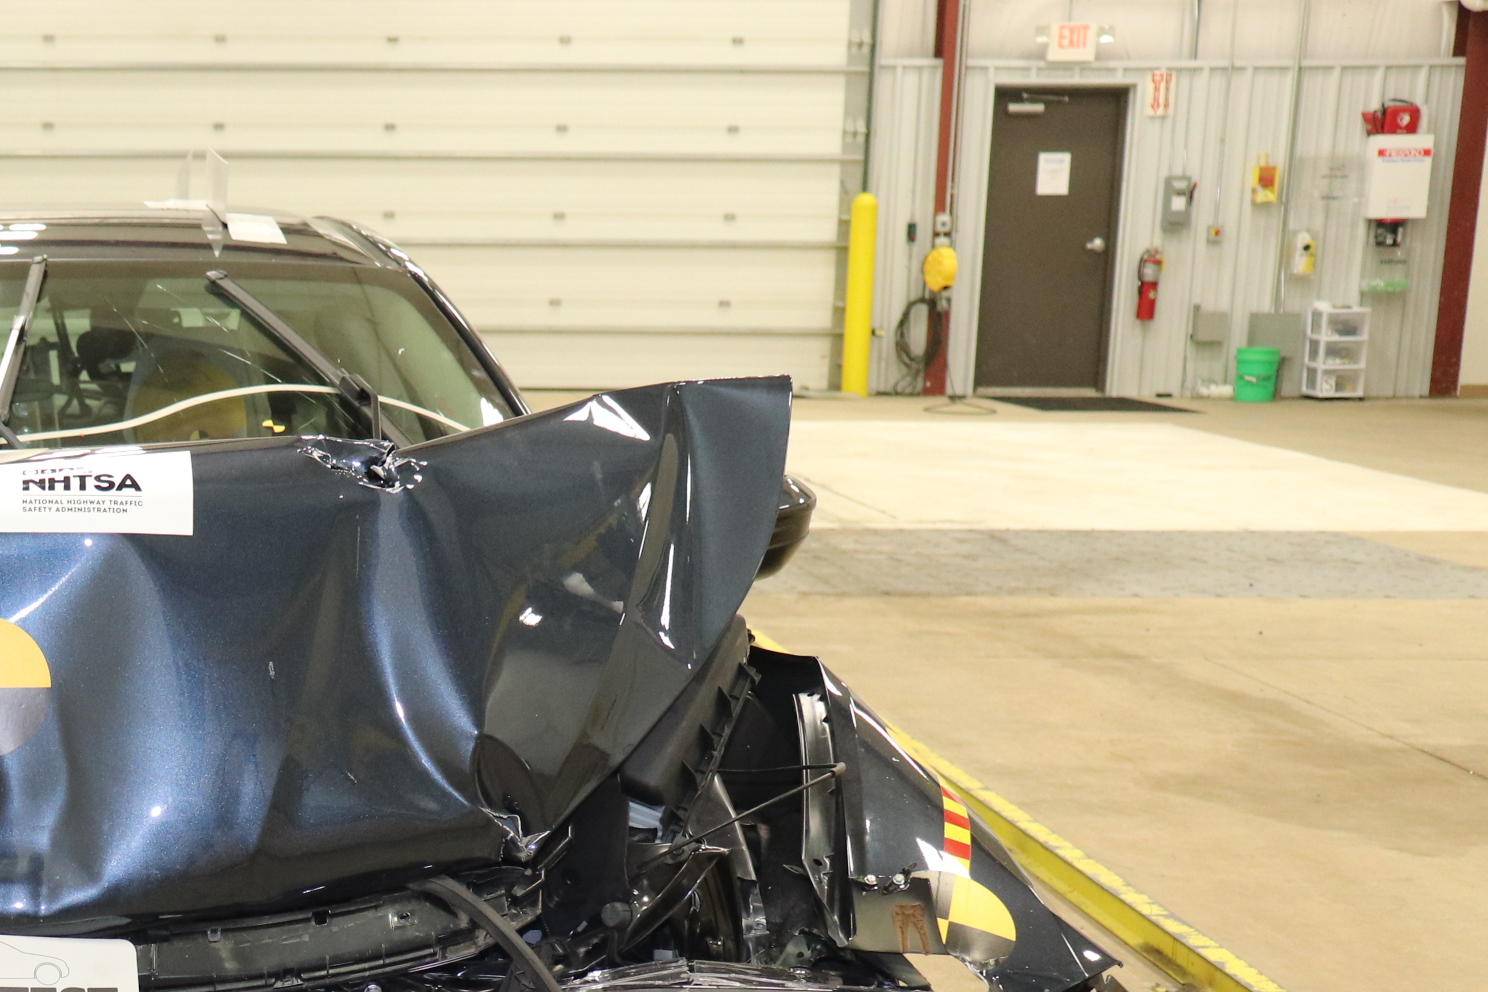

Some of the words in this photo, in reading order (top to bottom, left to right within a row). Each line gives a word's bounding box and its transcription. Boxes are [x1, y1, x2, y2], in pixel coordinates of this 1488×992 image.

[1057, 24, 1090, 50] EXIT
[22, 473, 143, 492] NHTSA
[109, 499, 143, 507] TRAFFIC
[55, 506, 128, 514] ADMINISTRATION
